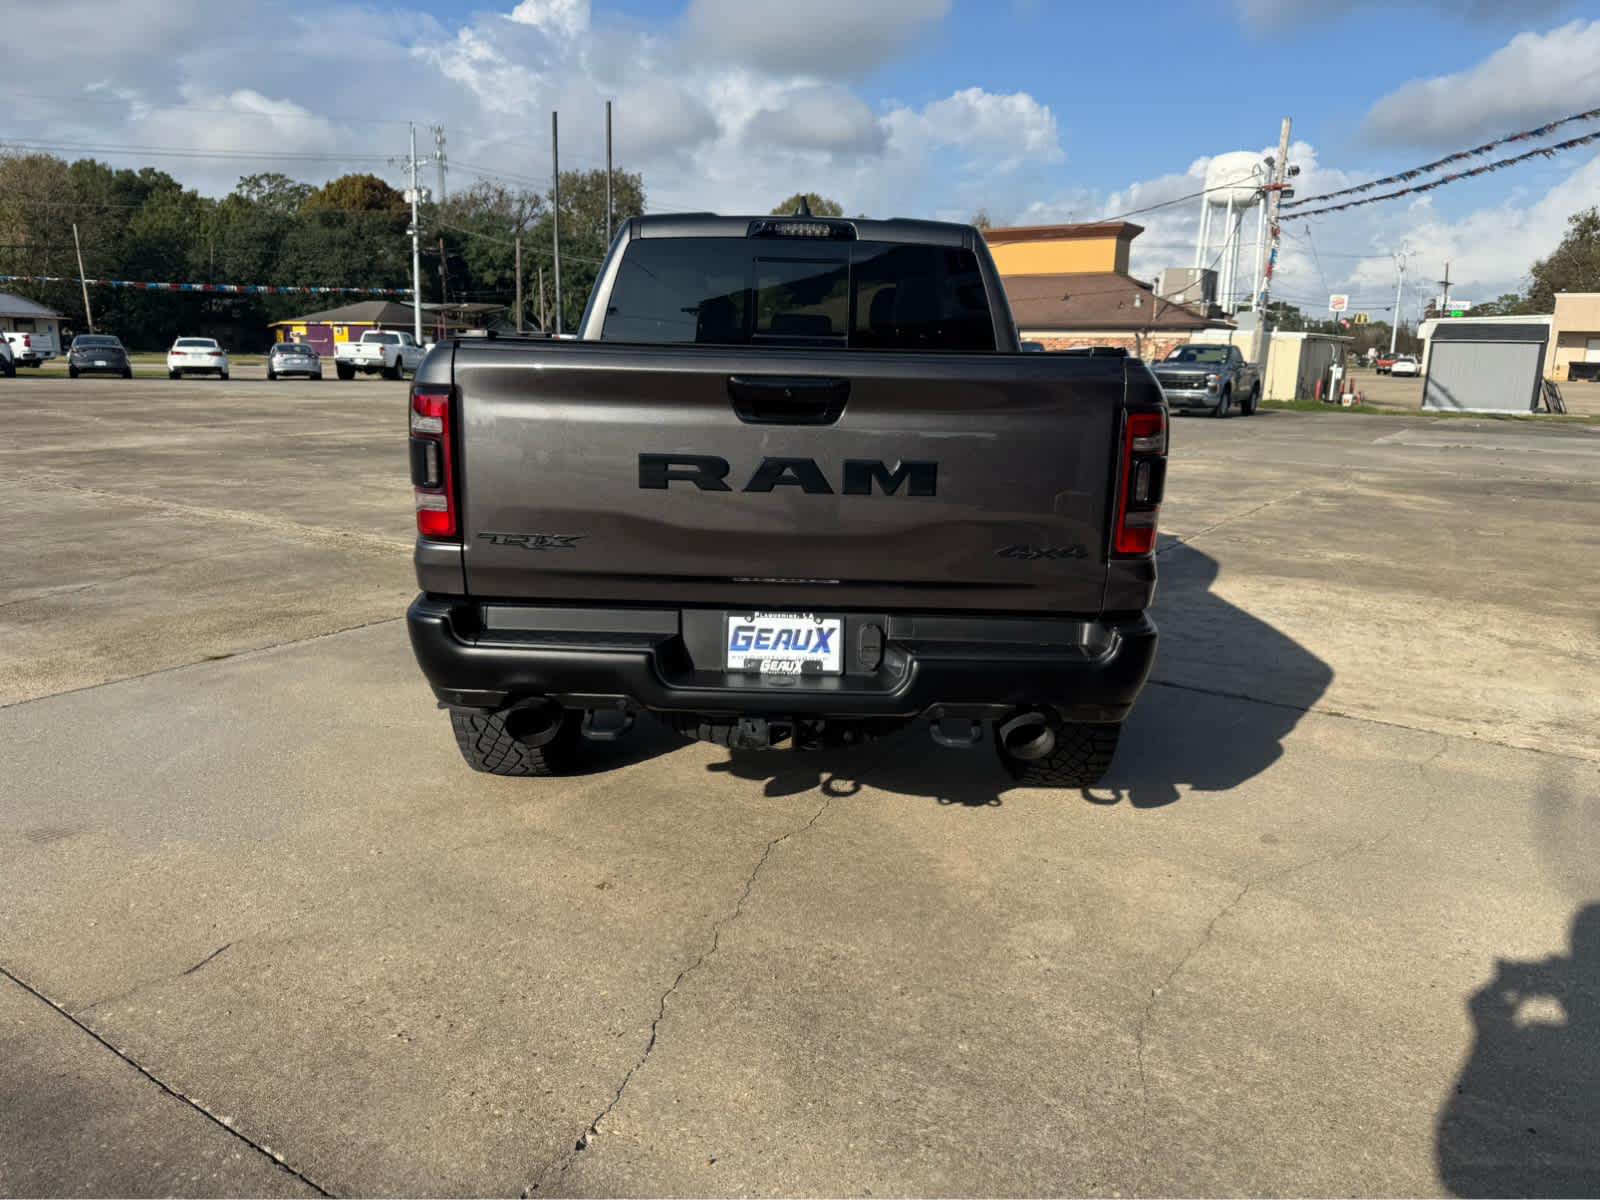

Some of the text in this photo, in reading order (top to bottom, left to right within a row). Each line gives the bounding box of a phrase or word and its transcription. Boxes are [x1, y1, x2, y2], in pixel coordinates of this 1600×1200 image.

[639, 453, 938, 496] RAM
[729, 625, 836, 654] GEAUX
[760, 660, 802, 671] GEAUX
